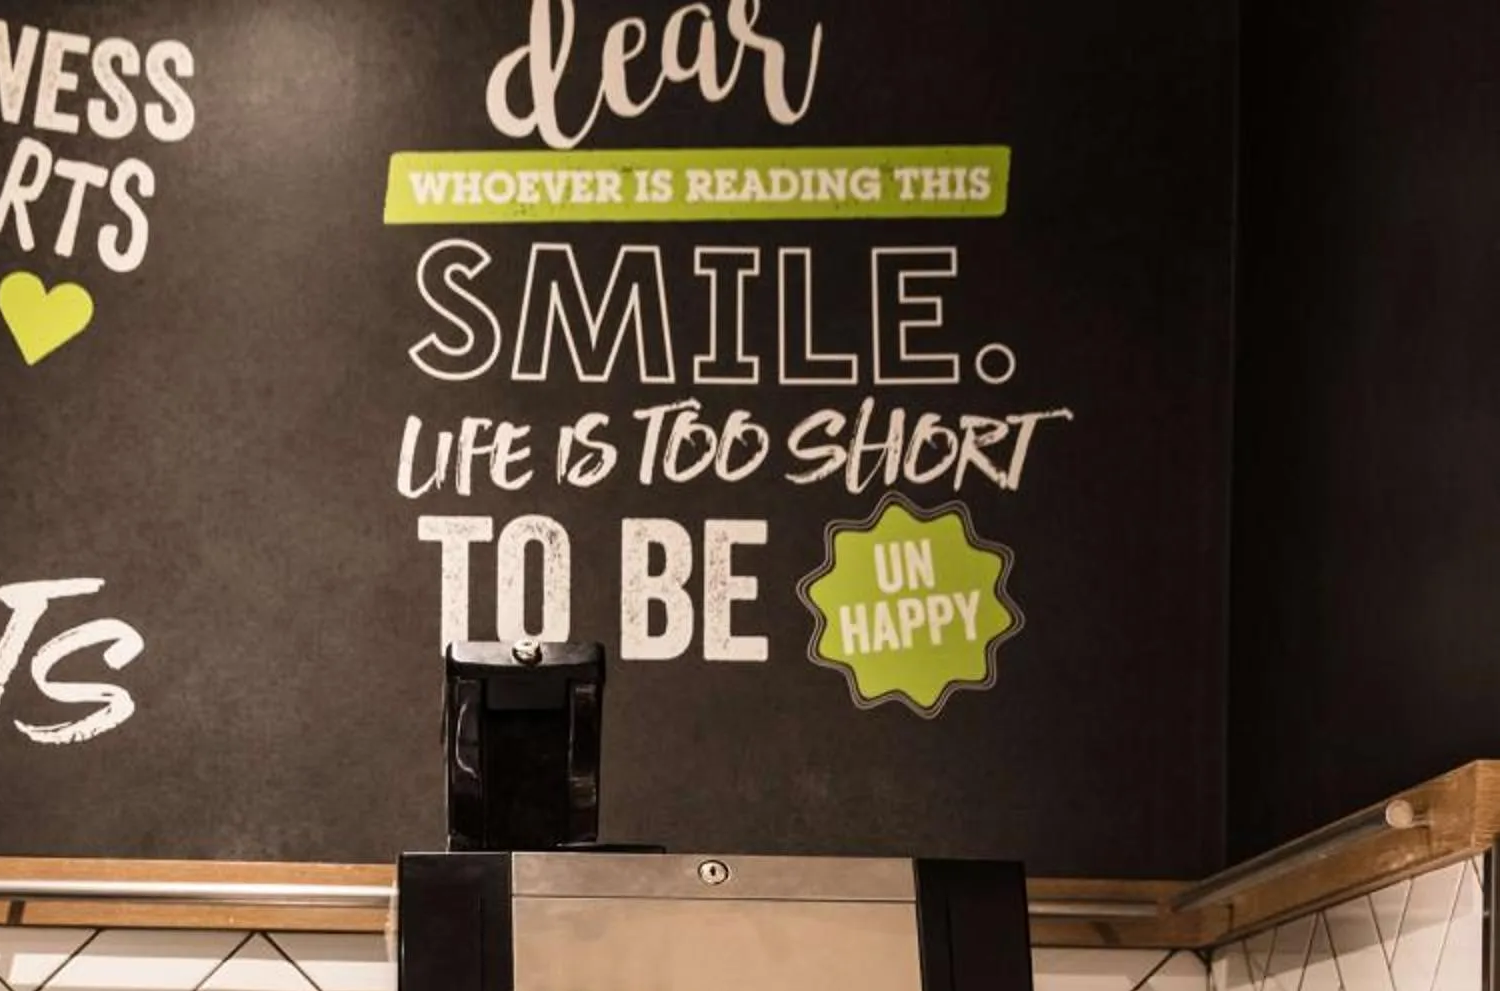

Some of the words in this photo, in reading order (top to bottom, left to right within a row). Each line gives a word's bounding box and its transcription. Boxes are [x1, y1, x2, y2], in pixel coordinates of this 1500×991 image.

[485, 0, 822, 149] dear
[409, 170, 622, 205] WHOEVER
[635, 169, 673, 203] IS
[686, 168, 881, 203] READING
[894, 167, 990, 201] THIS
[408, 238, 1016, 386] SMILE.
[396, 414, 534, 498] LIFE
[556, 412, 618, 488] IS
[633, 397, 770, 487] TOO
[785, 397, 1074, 493] SHORT
[417, 513, 572, 659] TO
[619, 517, 769, 662] BE
[873, 539, 937, 595] UN
[838, 590, 981, 656] HAPPY
